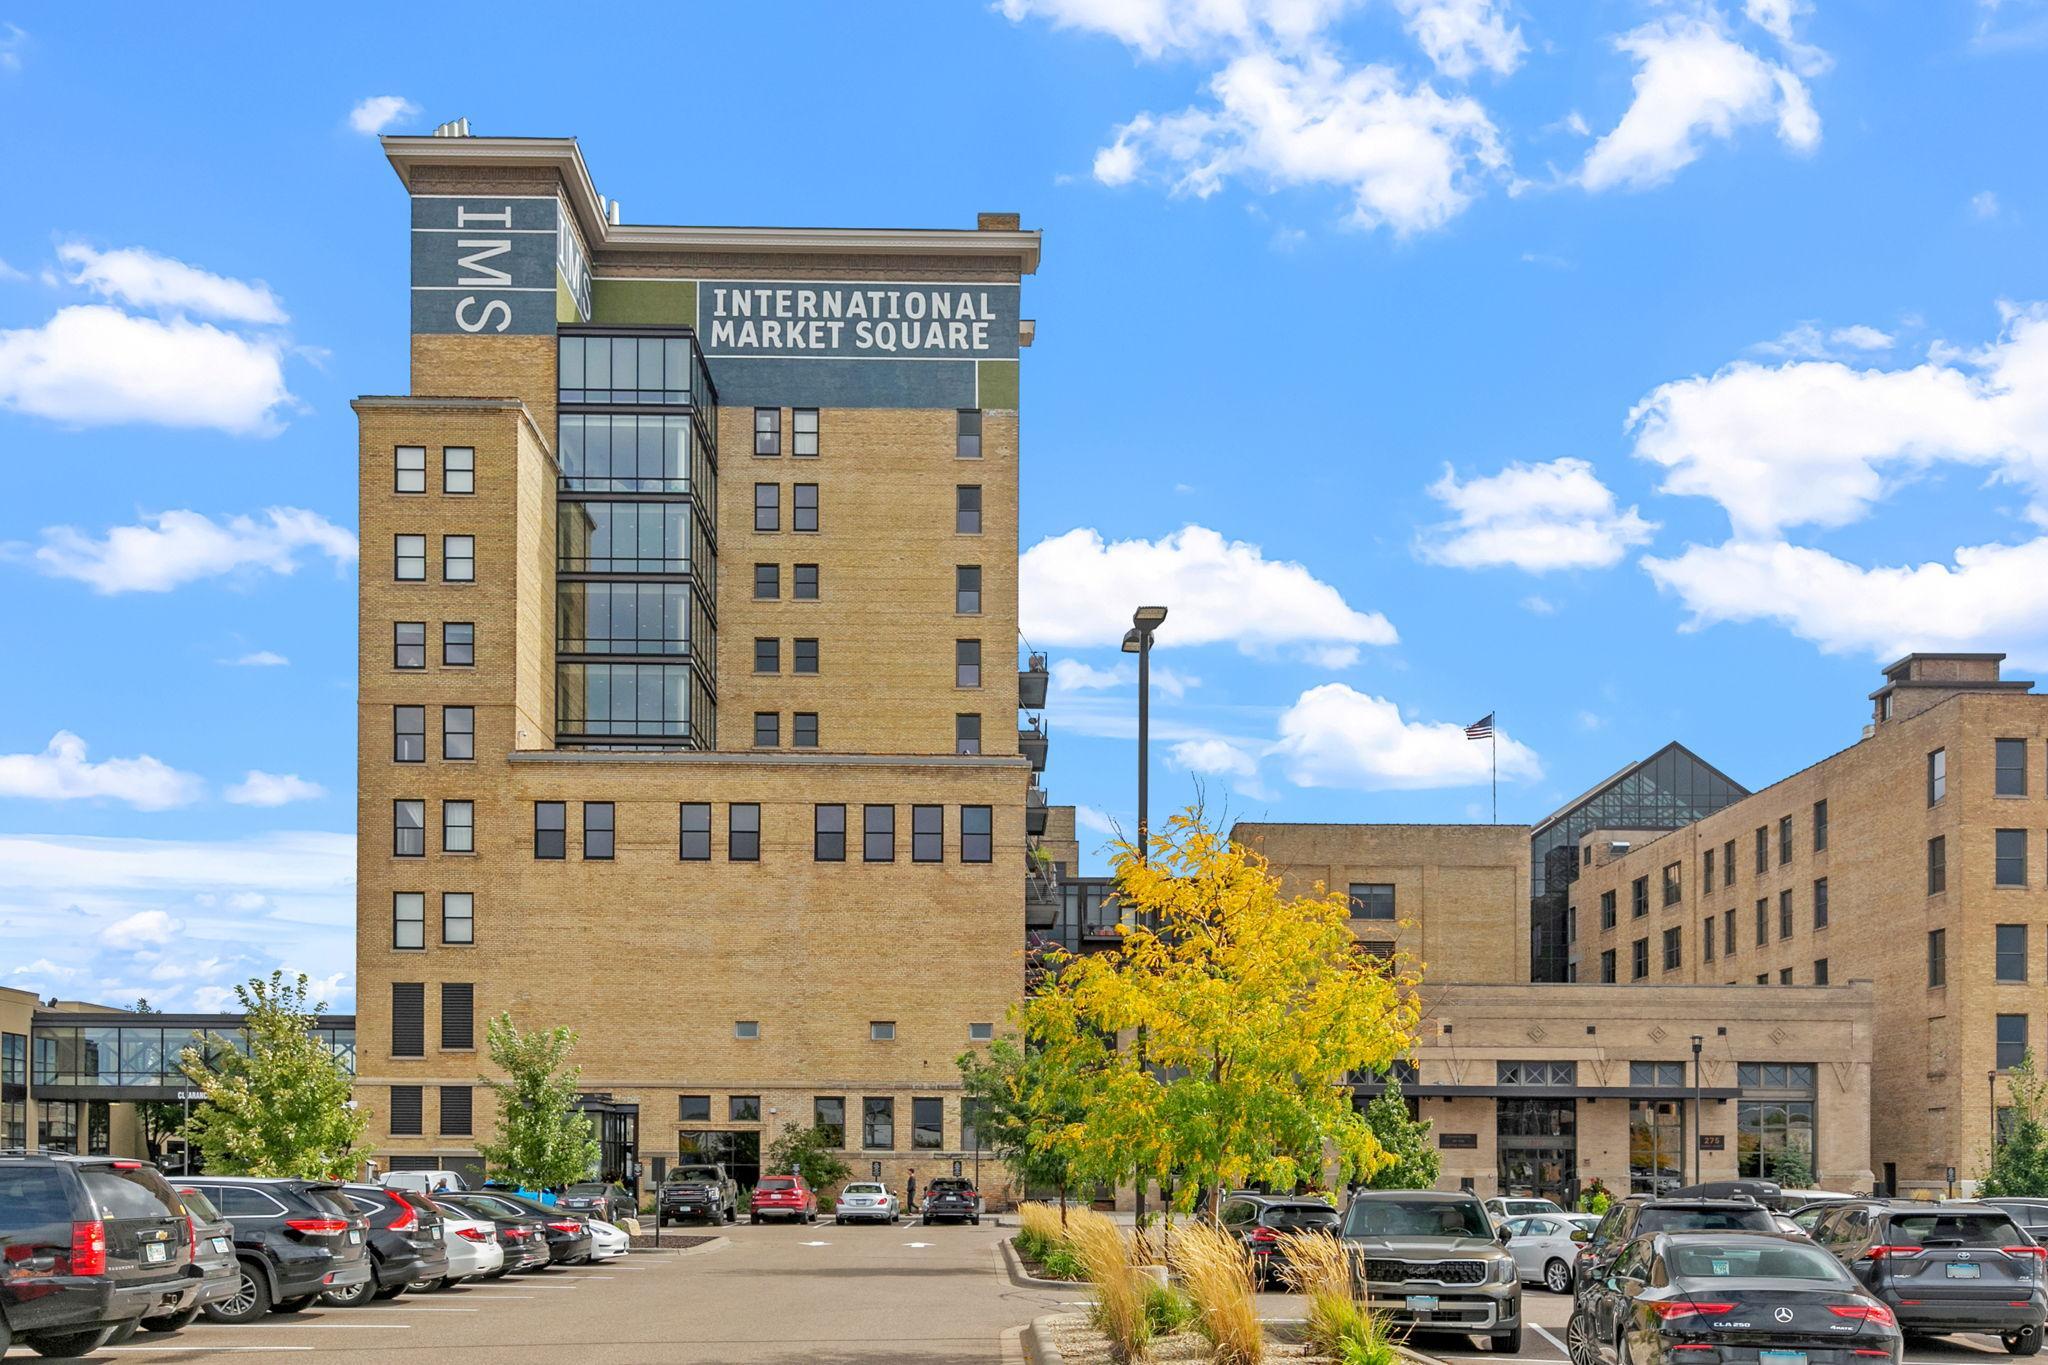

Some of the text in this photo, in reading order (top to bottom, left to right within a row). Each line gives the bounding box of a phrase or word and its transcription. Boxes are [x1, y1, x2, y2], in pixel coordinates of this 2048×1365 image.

[455, 205, 512, 333] IMS
[558, 212, 592, 321] IMS
[713, 288, 996, 321] INTERNATIONAL
[711, 320, 990, 352] MARKET SQUARE
[1704, 1137, 1720, 1145] 275
